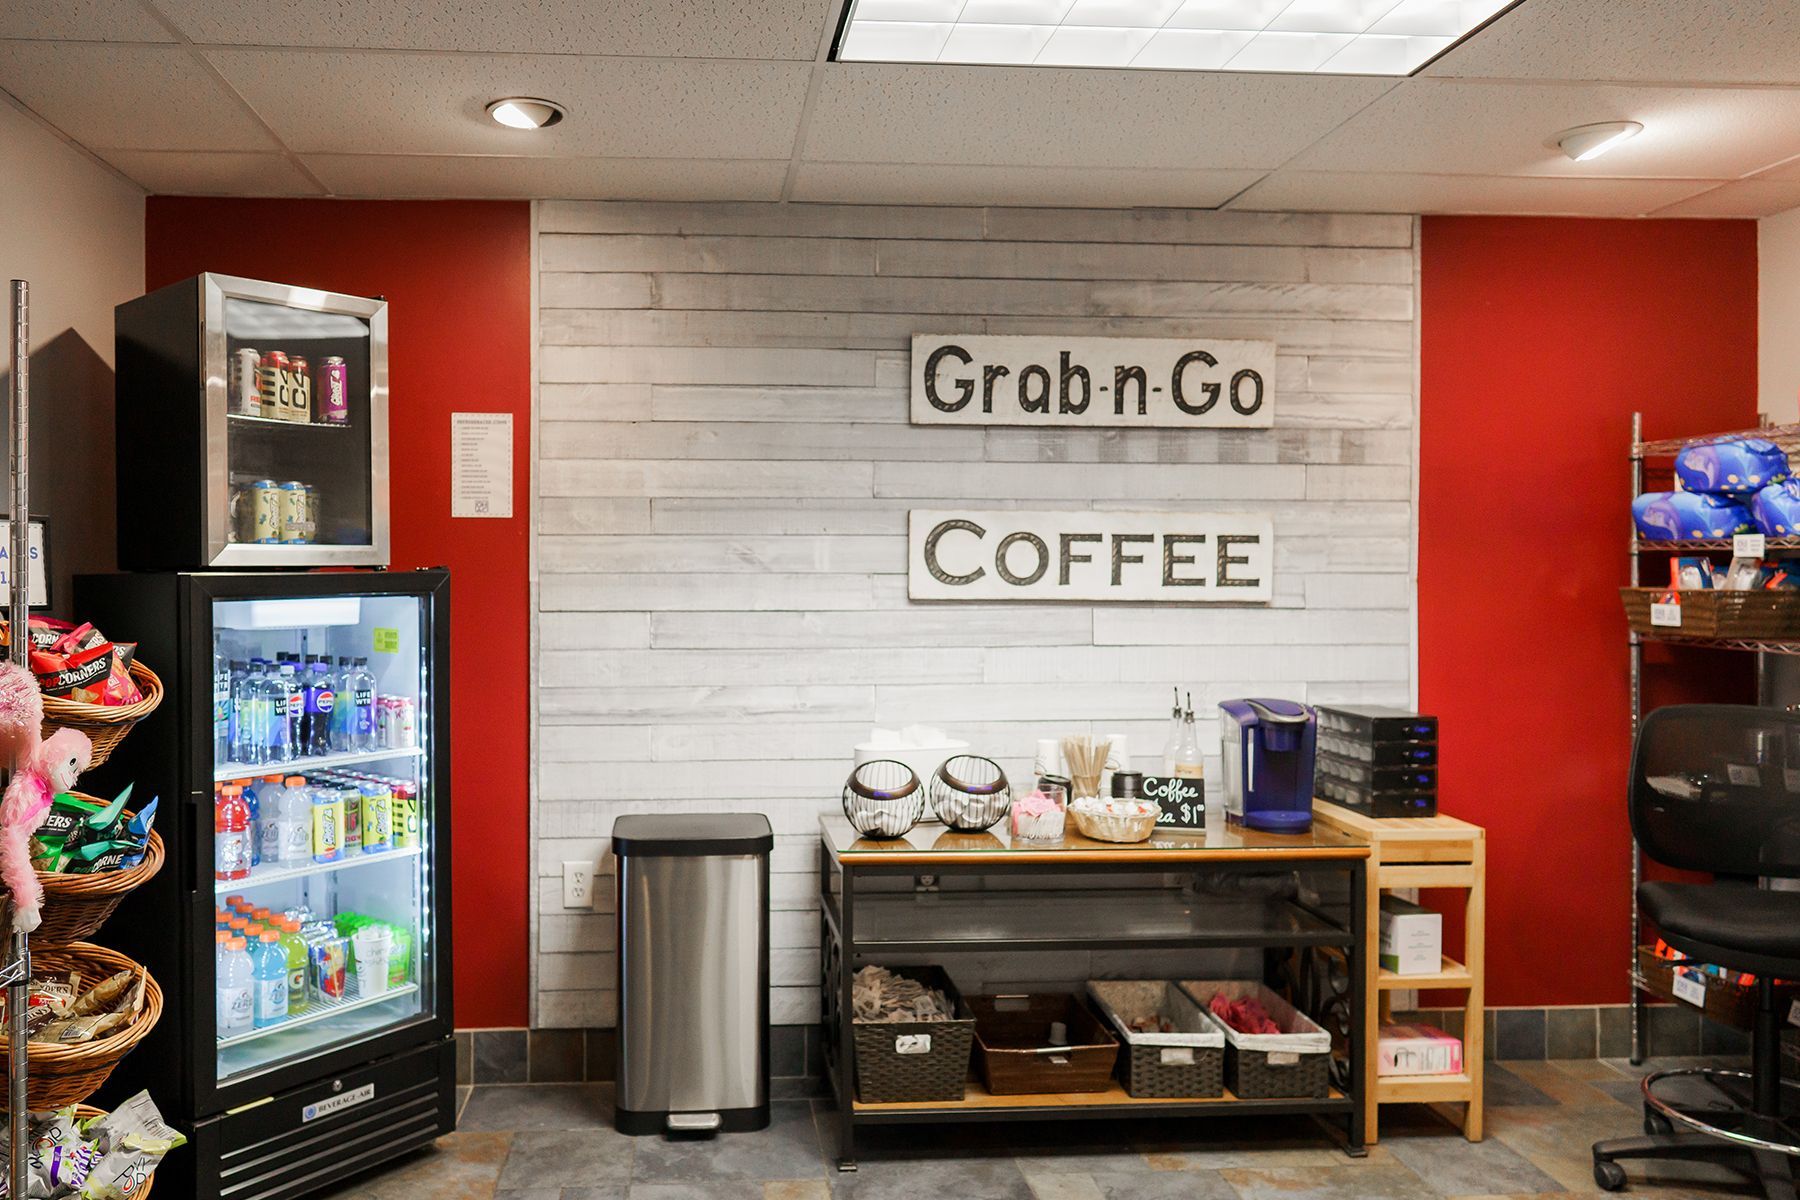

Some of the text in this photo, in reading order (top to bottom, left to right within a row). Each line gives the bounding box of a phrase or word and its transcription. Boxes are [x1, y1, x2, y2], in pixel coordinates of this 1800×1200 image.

[924, 344, 1264, 416] Grab-n-Go
[924, 519, 1261, 588] COFFEE
[355, 691, 371, 699] LIFE
[1143, 777, 1199, 803] Coffee
